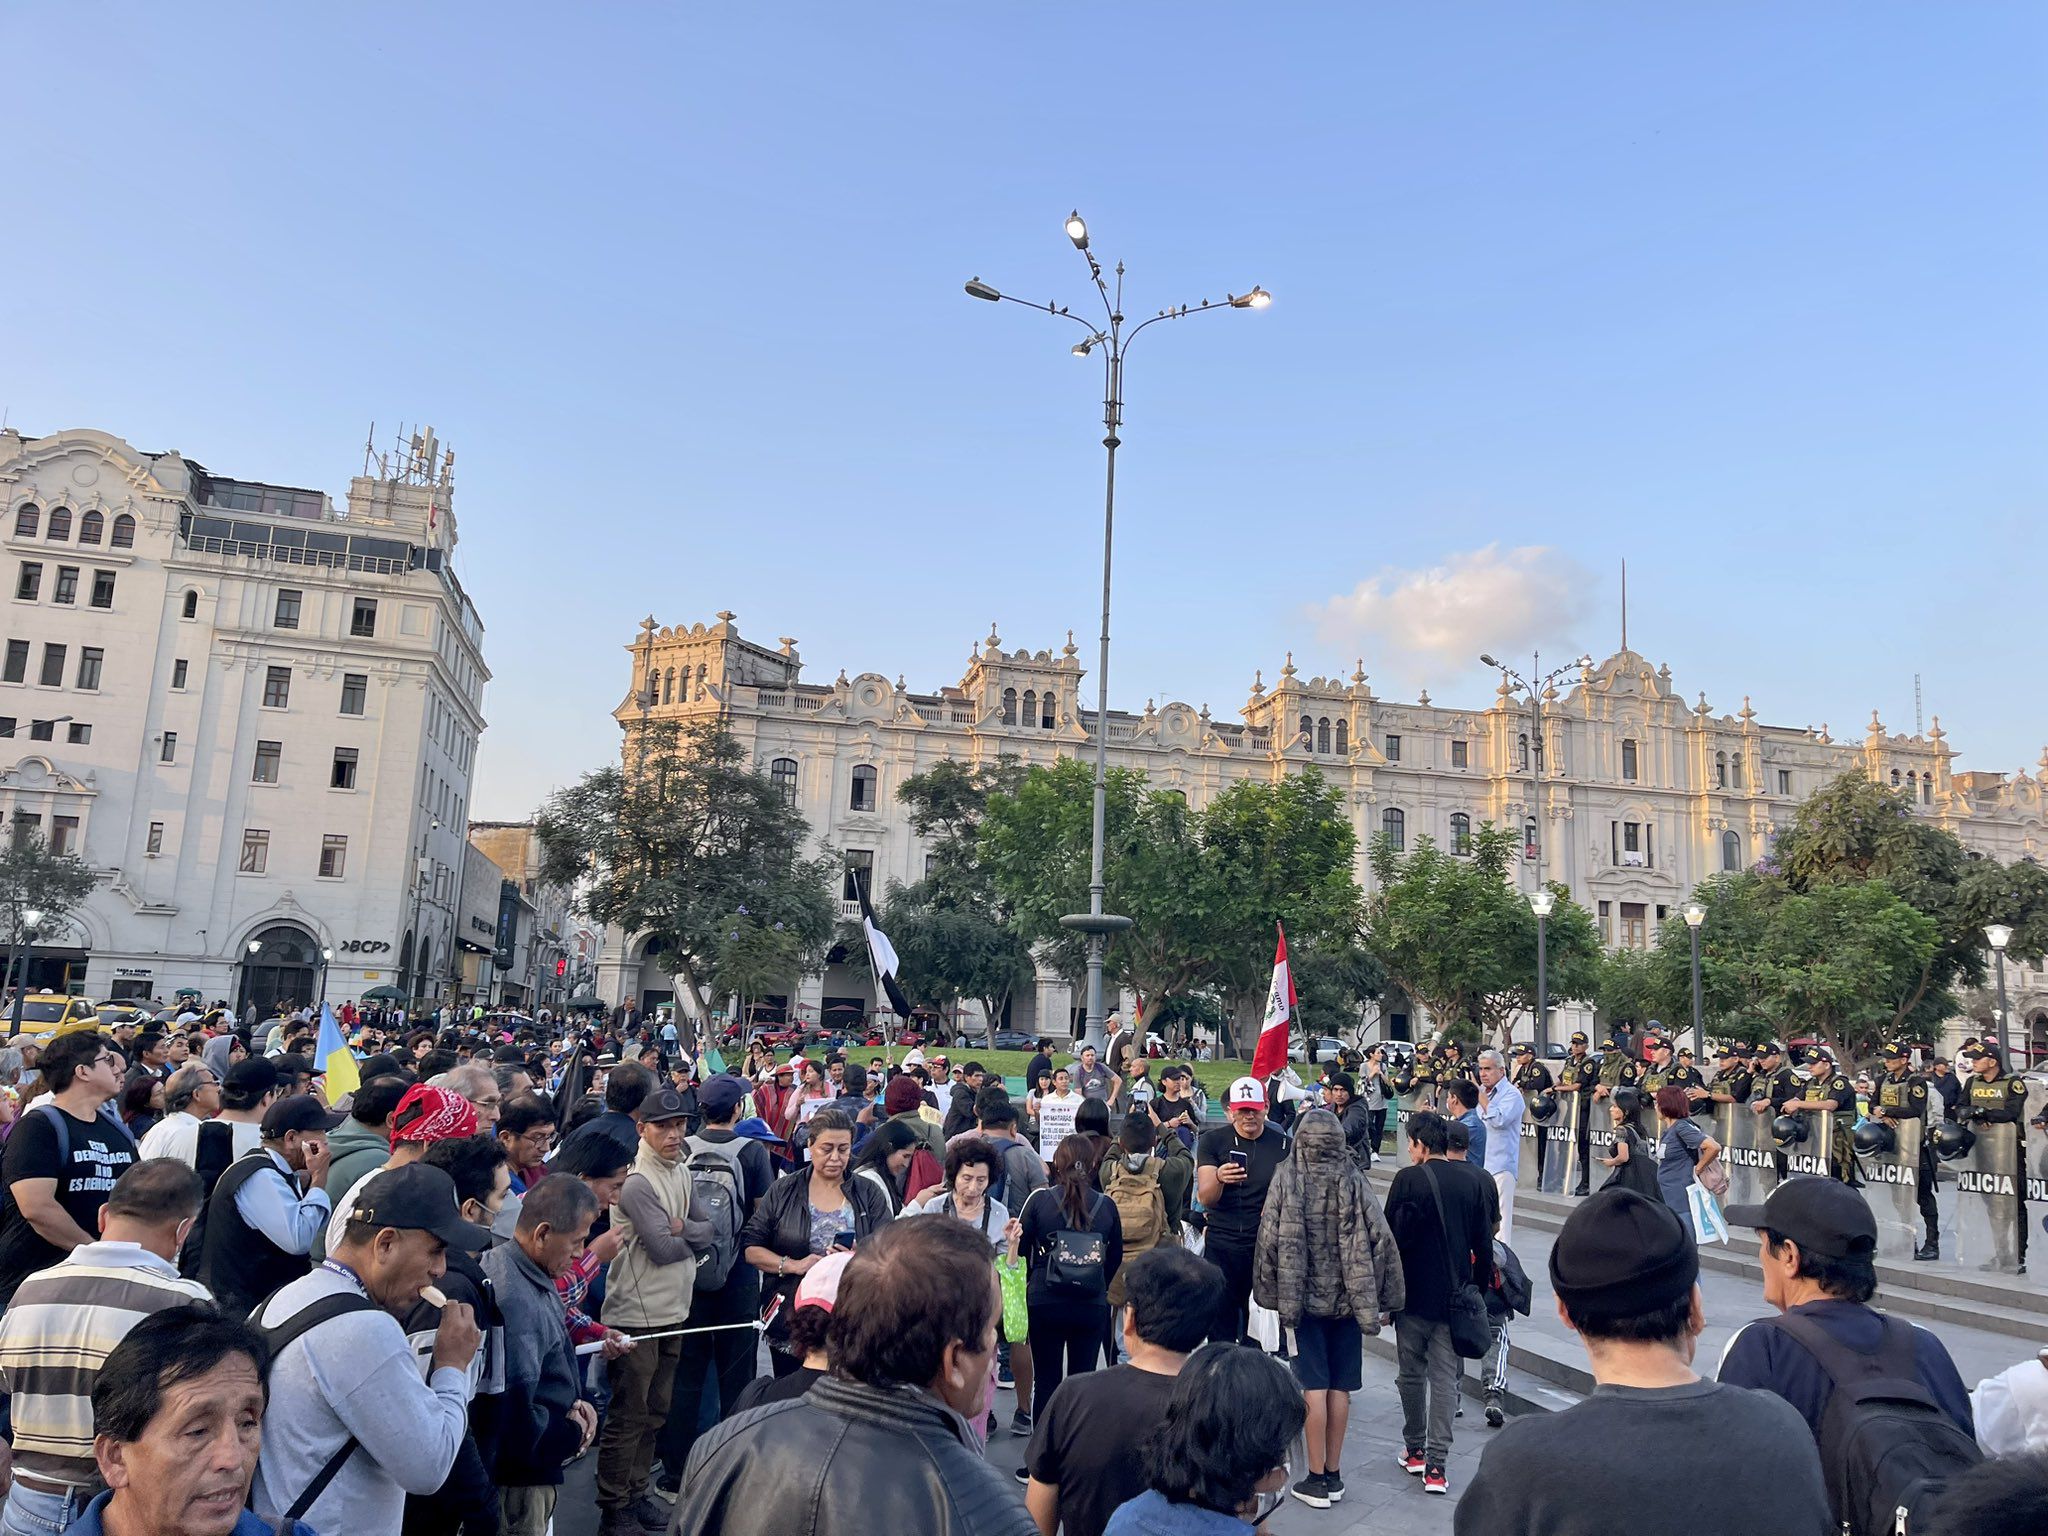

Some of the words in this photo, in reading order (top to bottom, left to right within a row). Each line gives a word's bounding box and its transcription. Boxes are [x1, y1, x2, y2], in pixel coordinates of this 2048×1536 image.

[1972, 1088, 2004, 1098] POLICIA
[69, 1178, 83, 1192] ES
[1957, 1171, 2015, 1196] POLICIA
